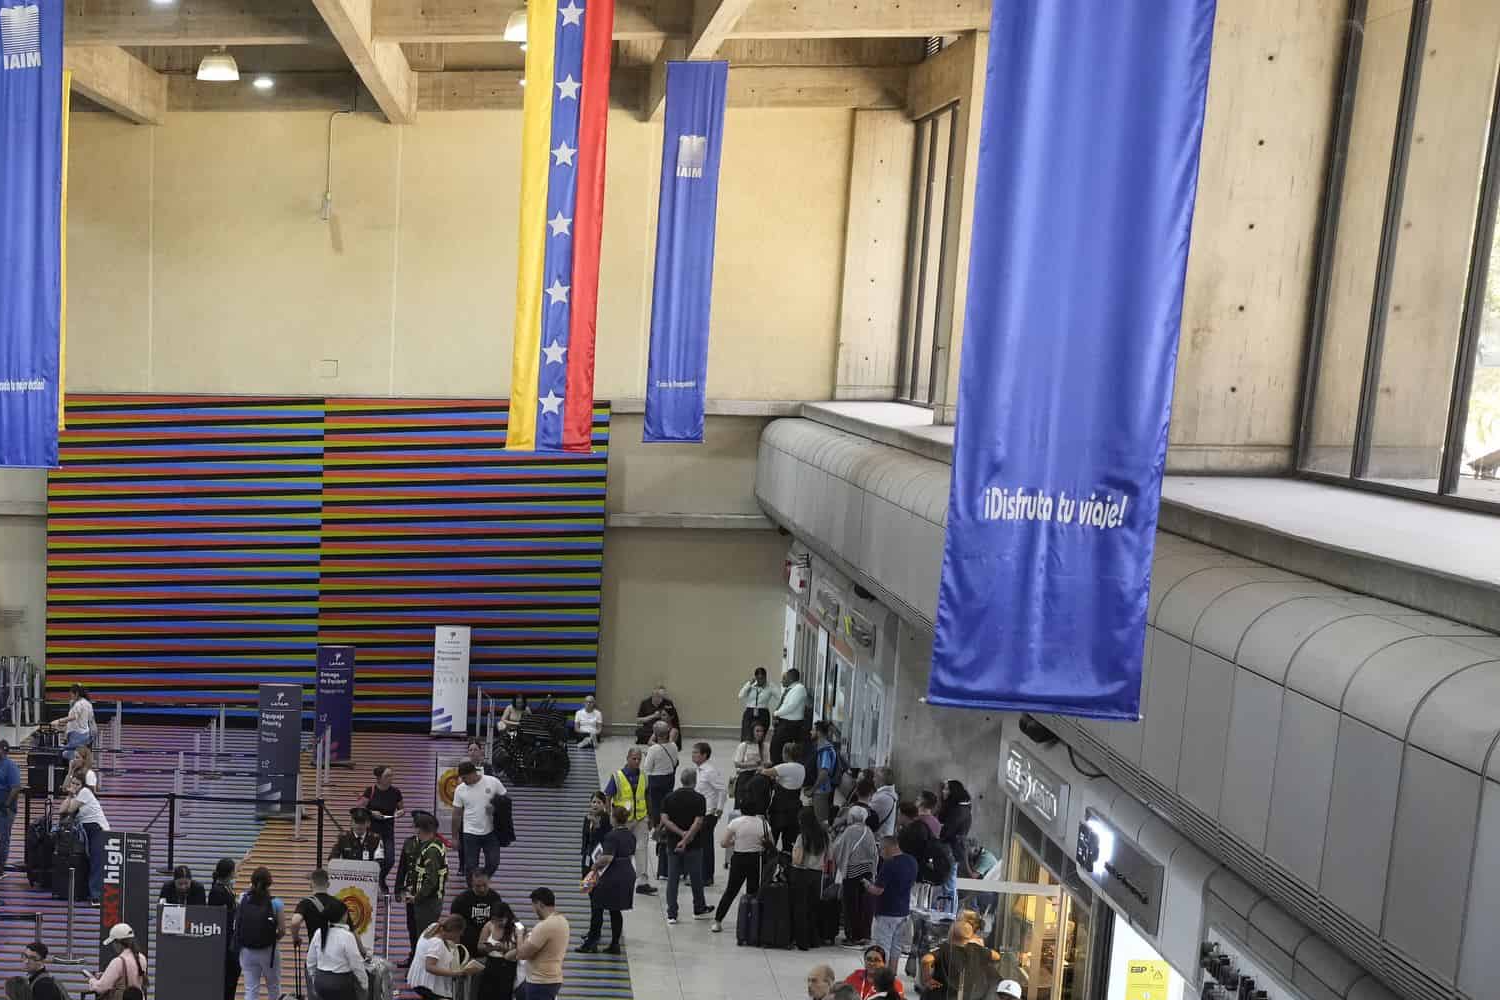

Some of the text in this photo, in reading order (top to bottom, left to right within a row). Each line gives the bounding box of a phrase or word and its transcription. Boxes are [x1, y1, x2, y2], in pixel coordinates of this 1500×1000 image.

[4, 52, 41, 70] IAIM
[1056, 491, 1075, 524] tu
[1079, 493, 1128, 530] viaje!
